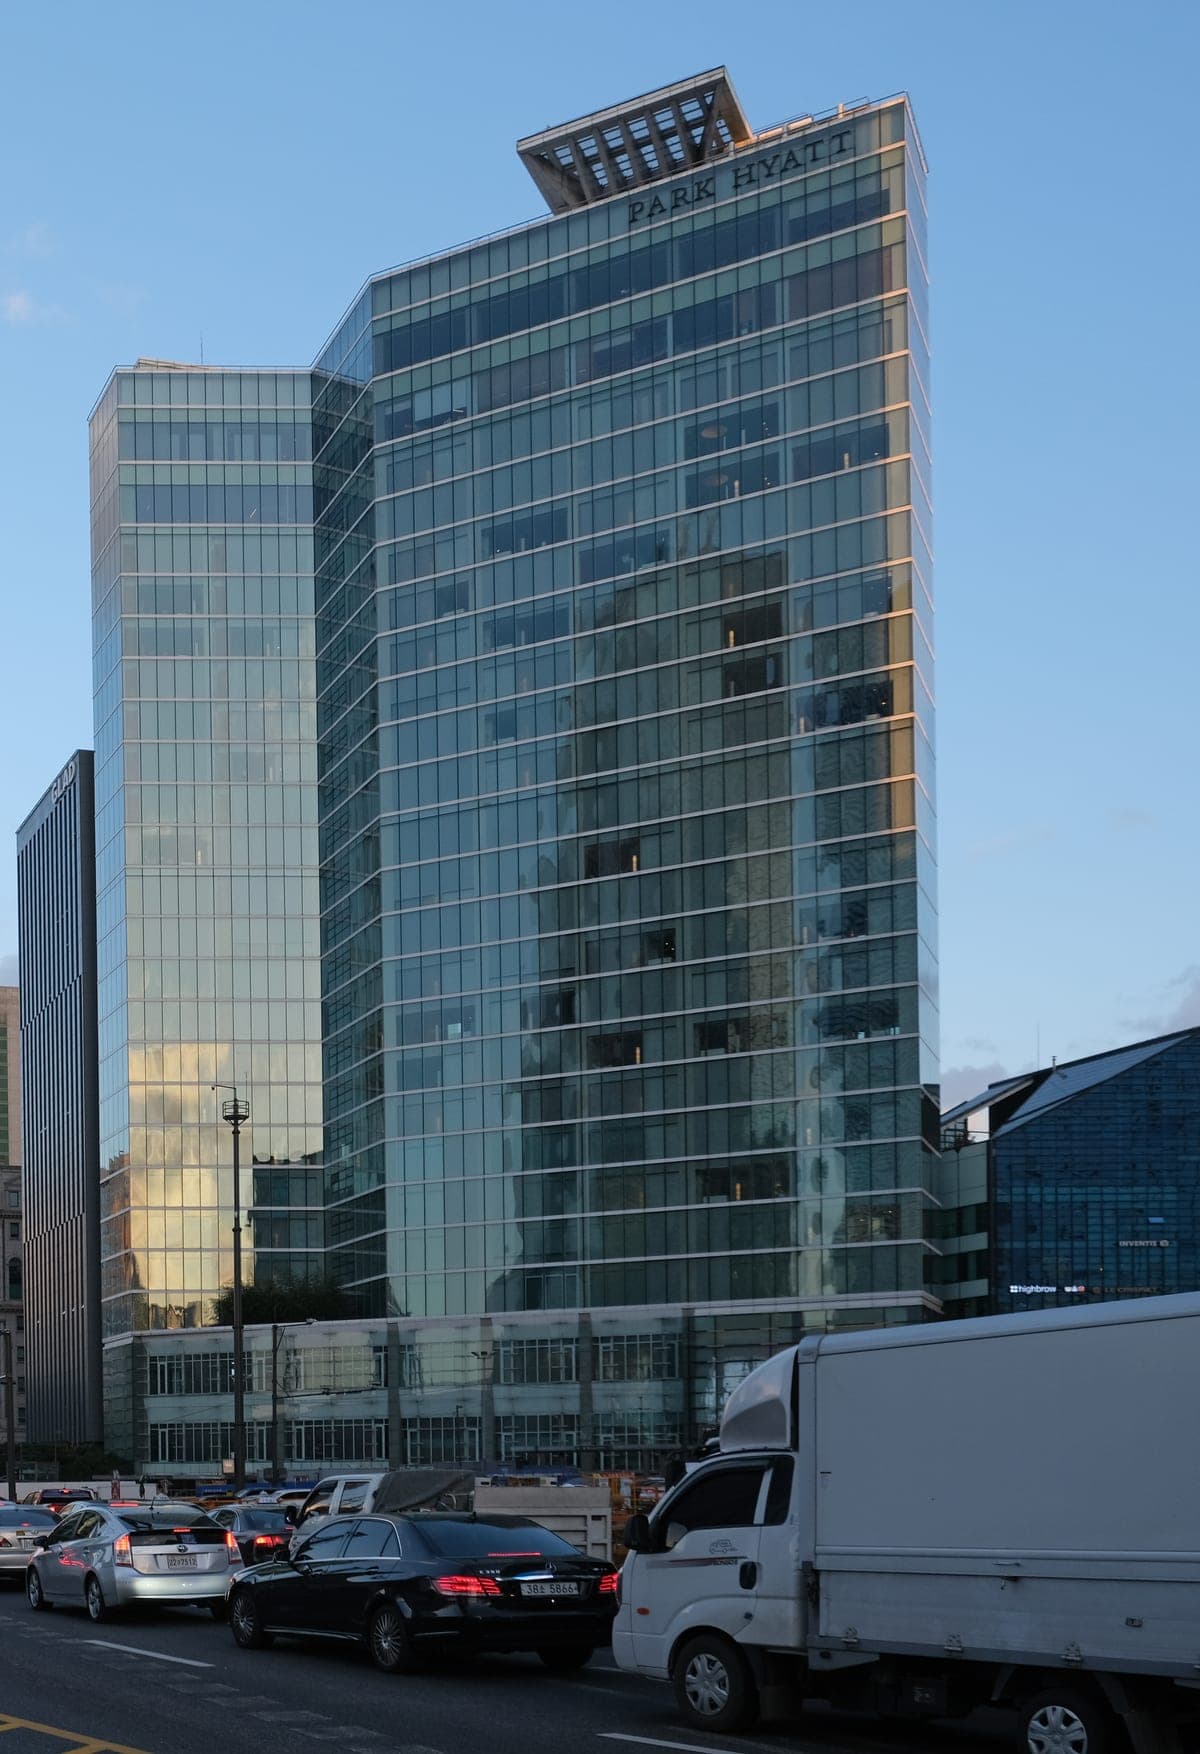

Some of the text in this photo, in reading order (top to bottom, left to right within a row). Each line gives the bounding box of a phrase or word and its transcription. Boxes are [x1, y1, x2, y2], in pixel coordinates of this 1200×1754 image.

[628, 130, 853, 223] PARK HYATT
[51, 761, 76, 804] GLAD
[1018, 1285, 1057, 1295] highbrow
[549, 1584, 574, 1594] 5866
